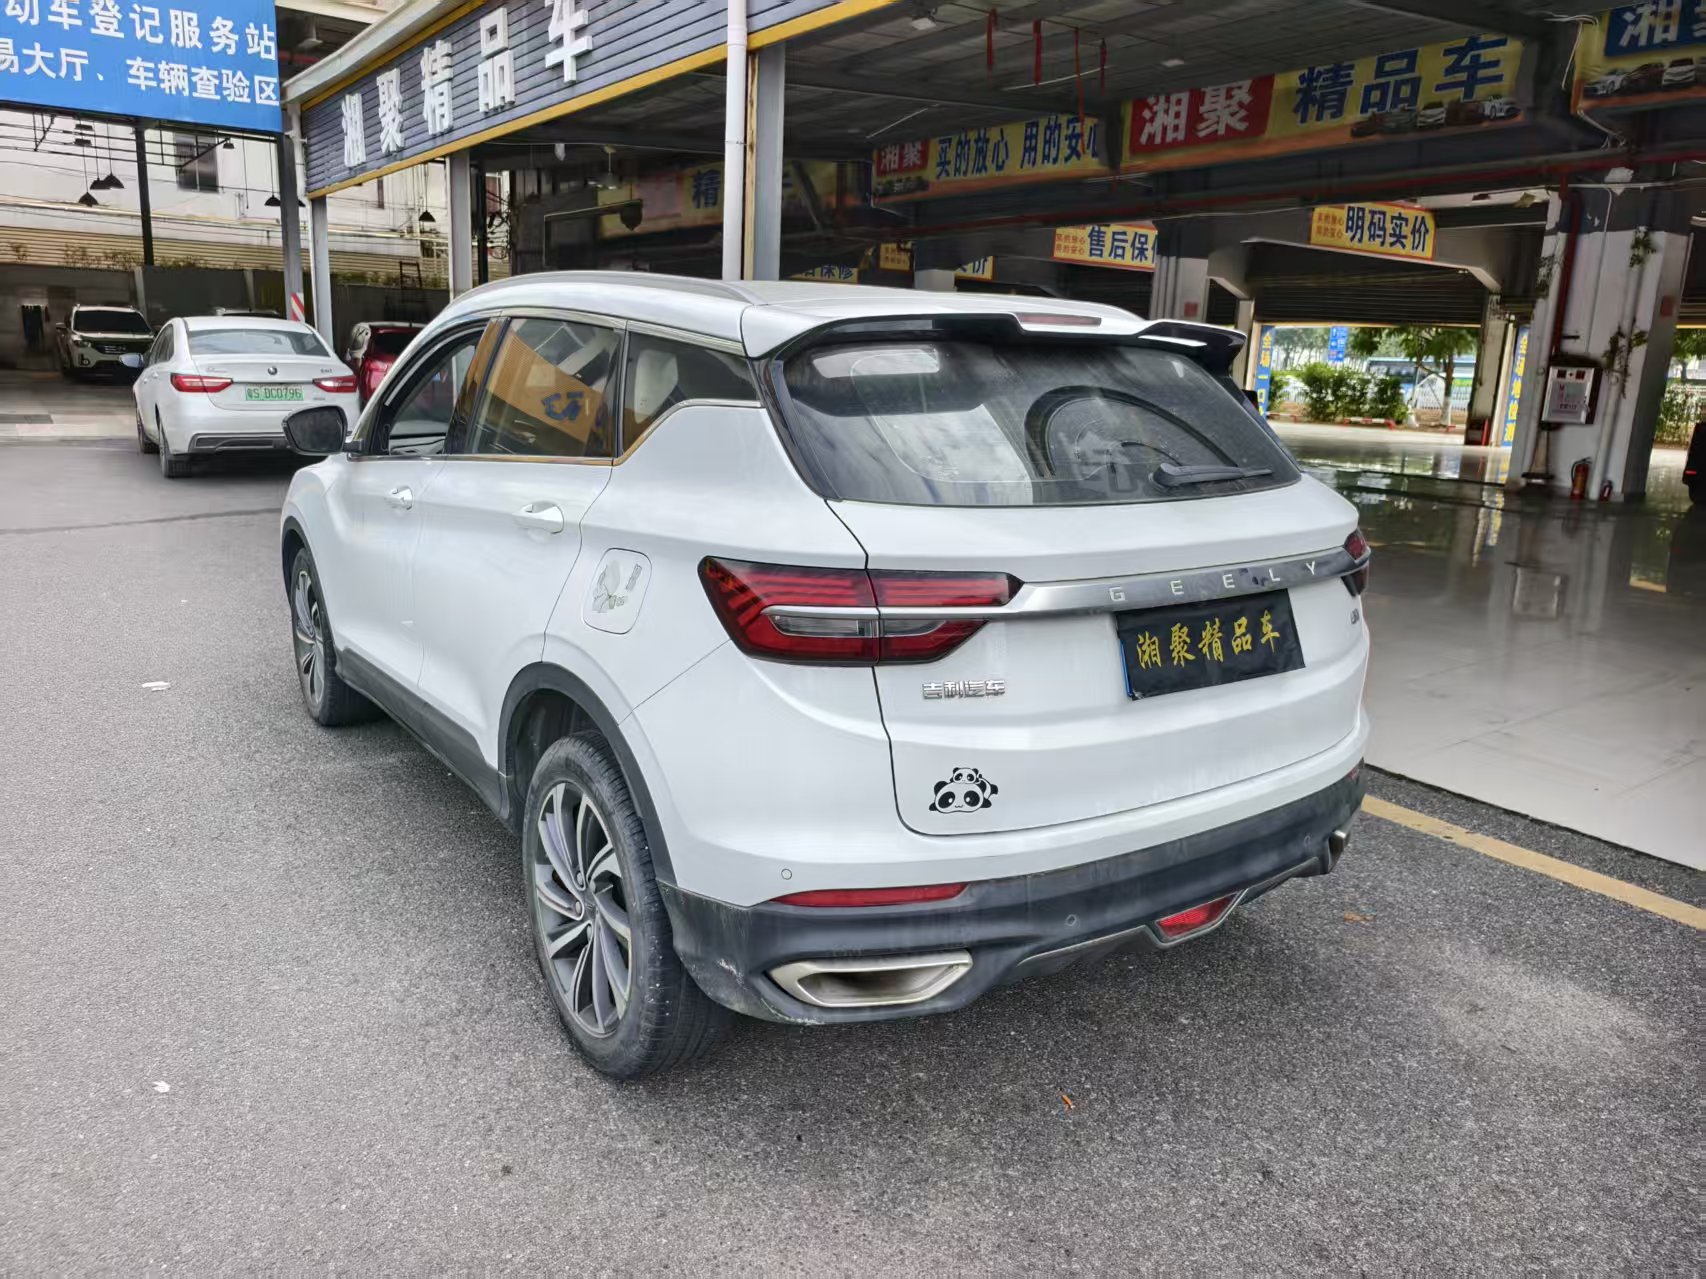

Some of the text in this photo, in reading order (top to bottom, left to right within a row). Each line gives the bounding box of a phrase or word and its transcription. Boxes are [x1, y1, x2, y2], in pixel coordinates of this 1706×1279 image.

[1619, 0, 1706, 47] 湘
[1139, 35, 1508, 146] 湘聚 精品车
[935, 128, 1010, 180] 买的放心
[1346, 205, 1429, 252] 明码实价
[1109, 560, 1316, 602] GEELY
[1136, 609, 1280, 669] 湘聚精品车
[922, 679, 1006, 700] 吉利汽车
